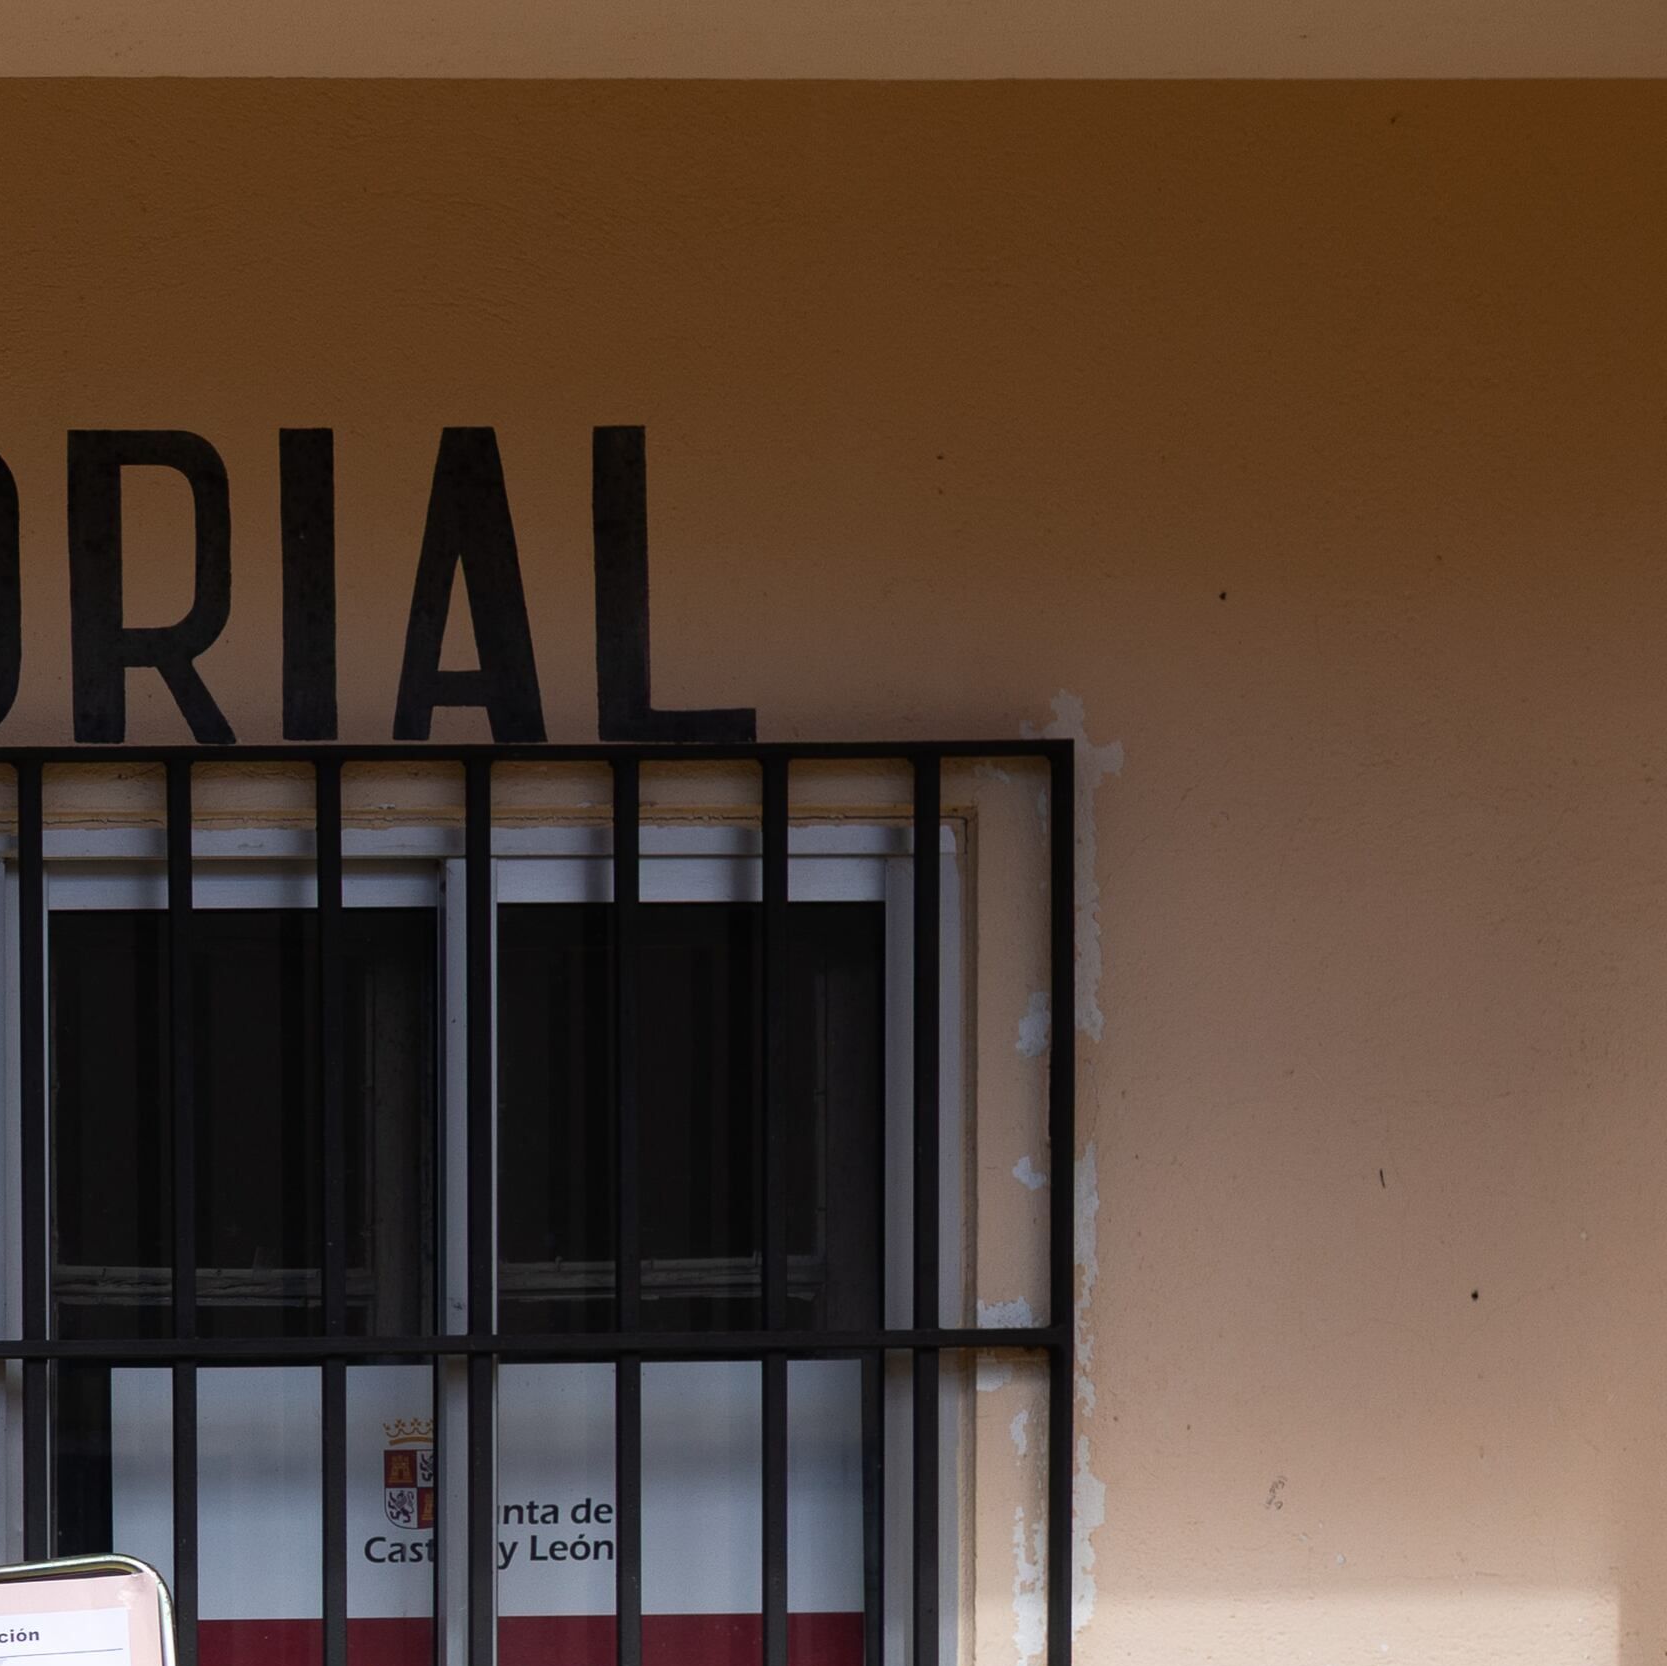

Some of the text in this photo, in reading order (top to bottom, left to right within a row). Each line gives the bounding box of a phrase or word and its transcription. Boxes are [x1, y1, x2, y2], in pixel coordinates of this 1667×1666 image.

[571, 1498, 614, 1524] de
[364, 1534, 614, 1570] Cast y León
